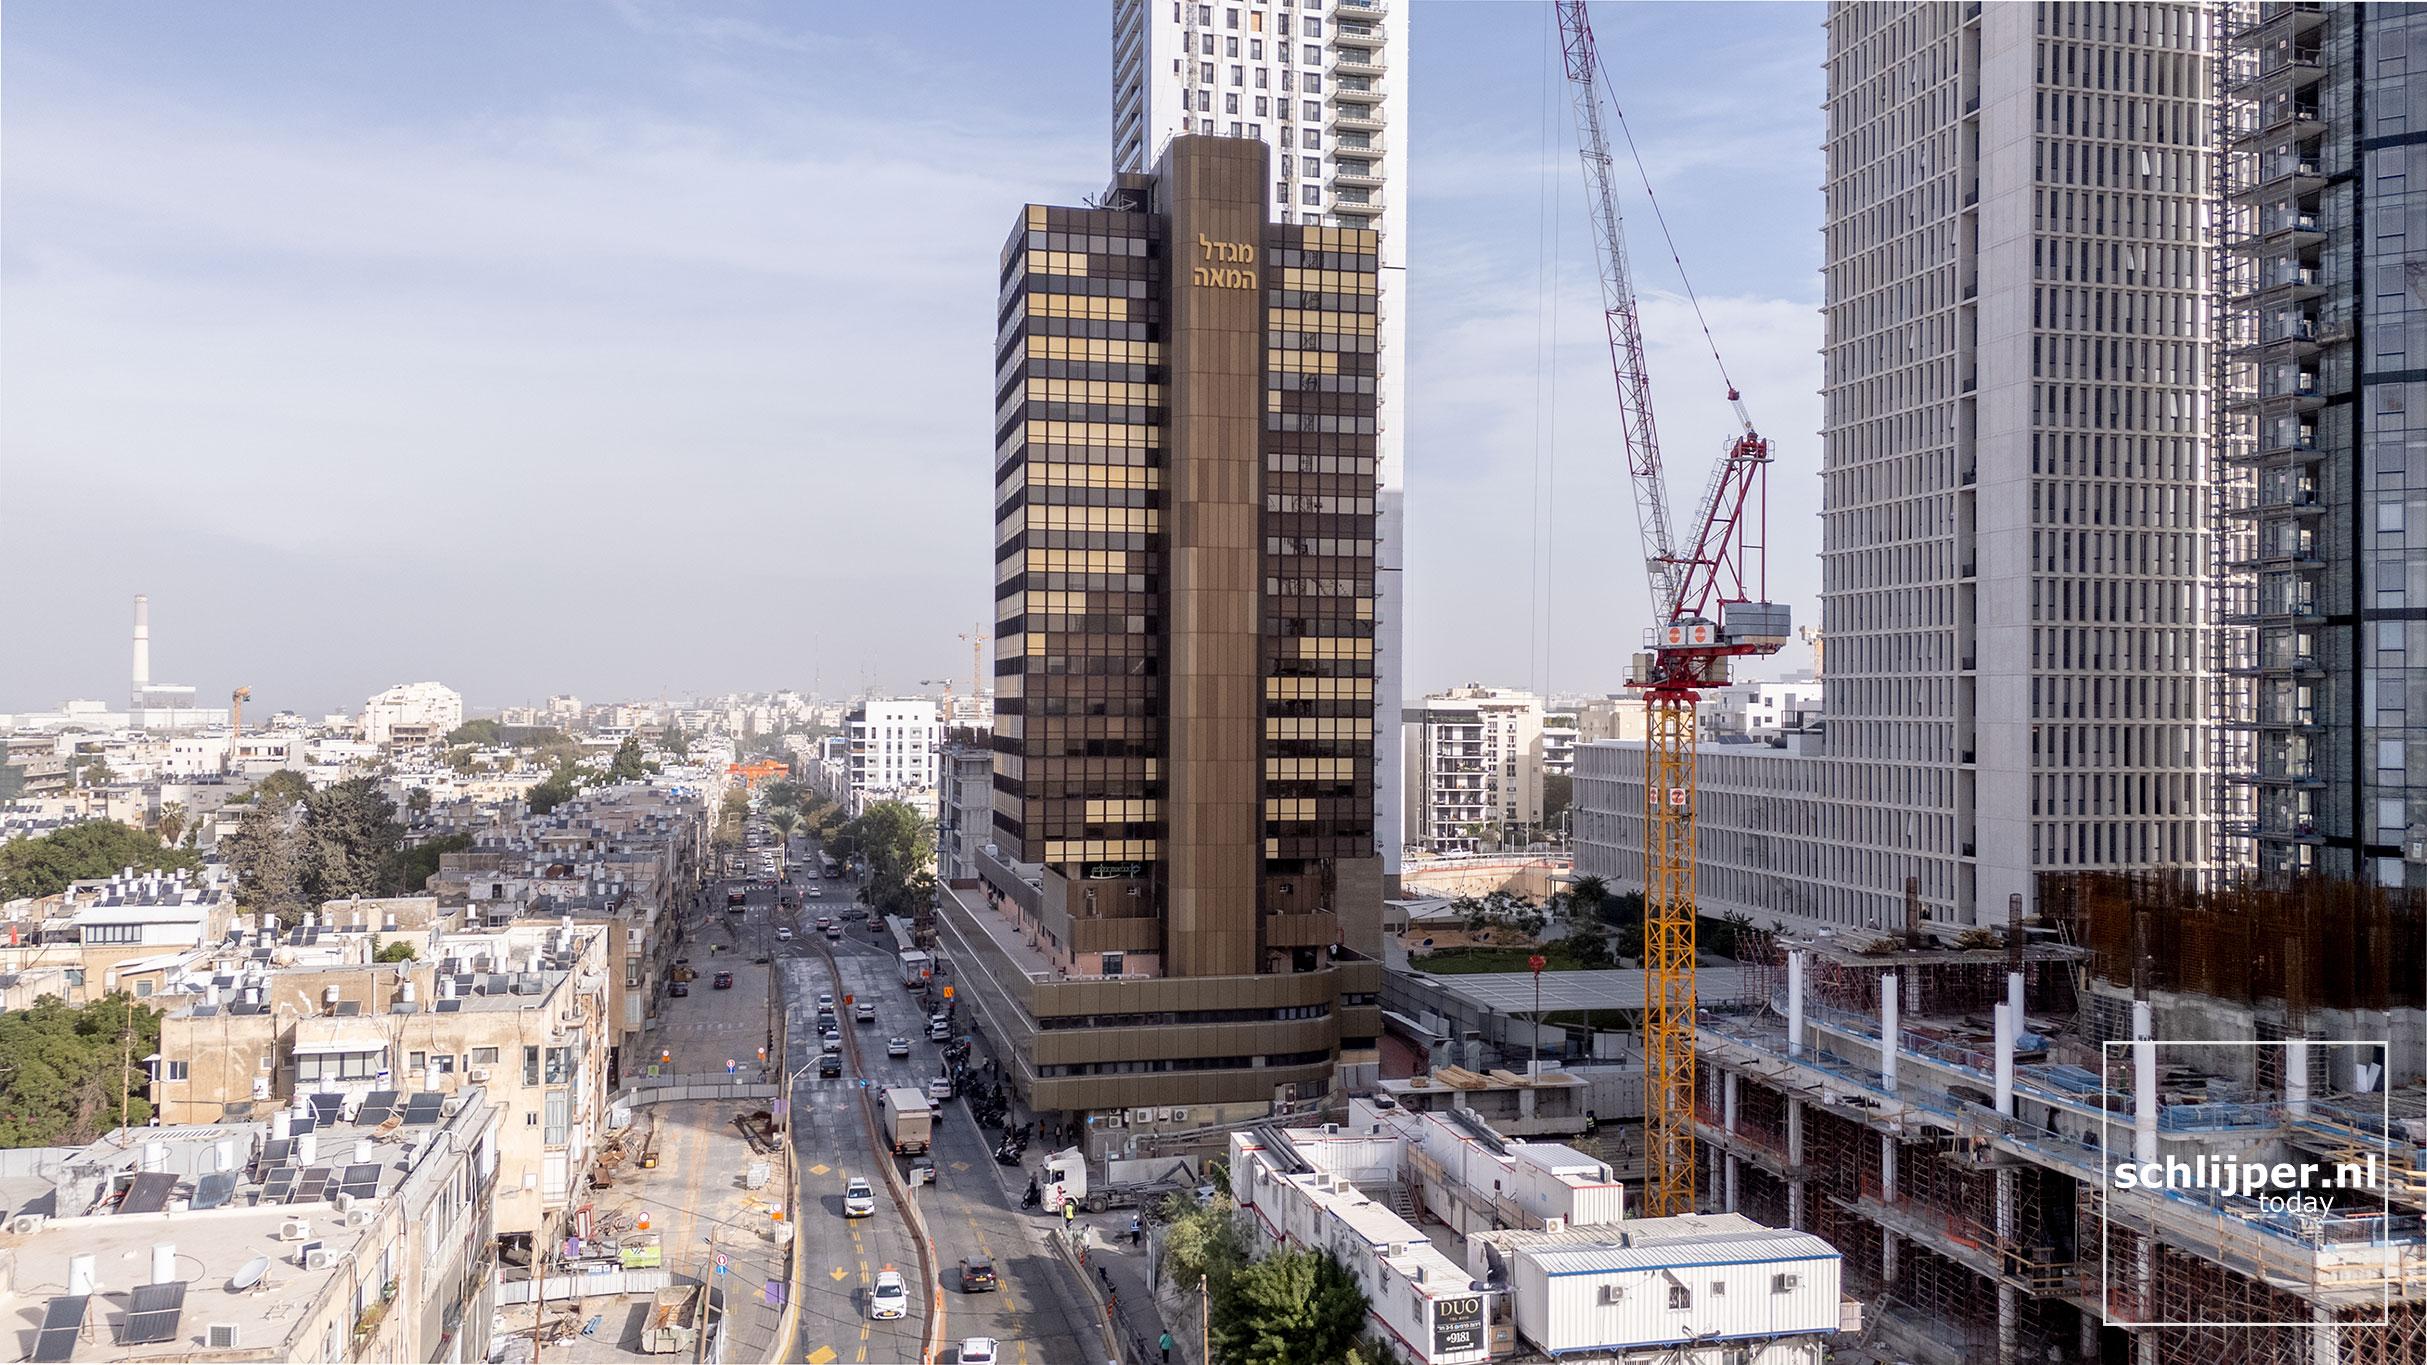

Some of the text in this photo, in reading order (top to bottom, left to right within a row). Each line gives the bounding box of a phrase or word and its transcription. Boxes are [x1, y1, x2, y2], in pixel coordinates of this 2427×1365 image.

[1199, 233, 1254, 263] מגדל
[1194, 267, 1257, 289] המאה
[1440, 1299, 1479, 1317] DUO
